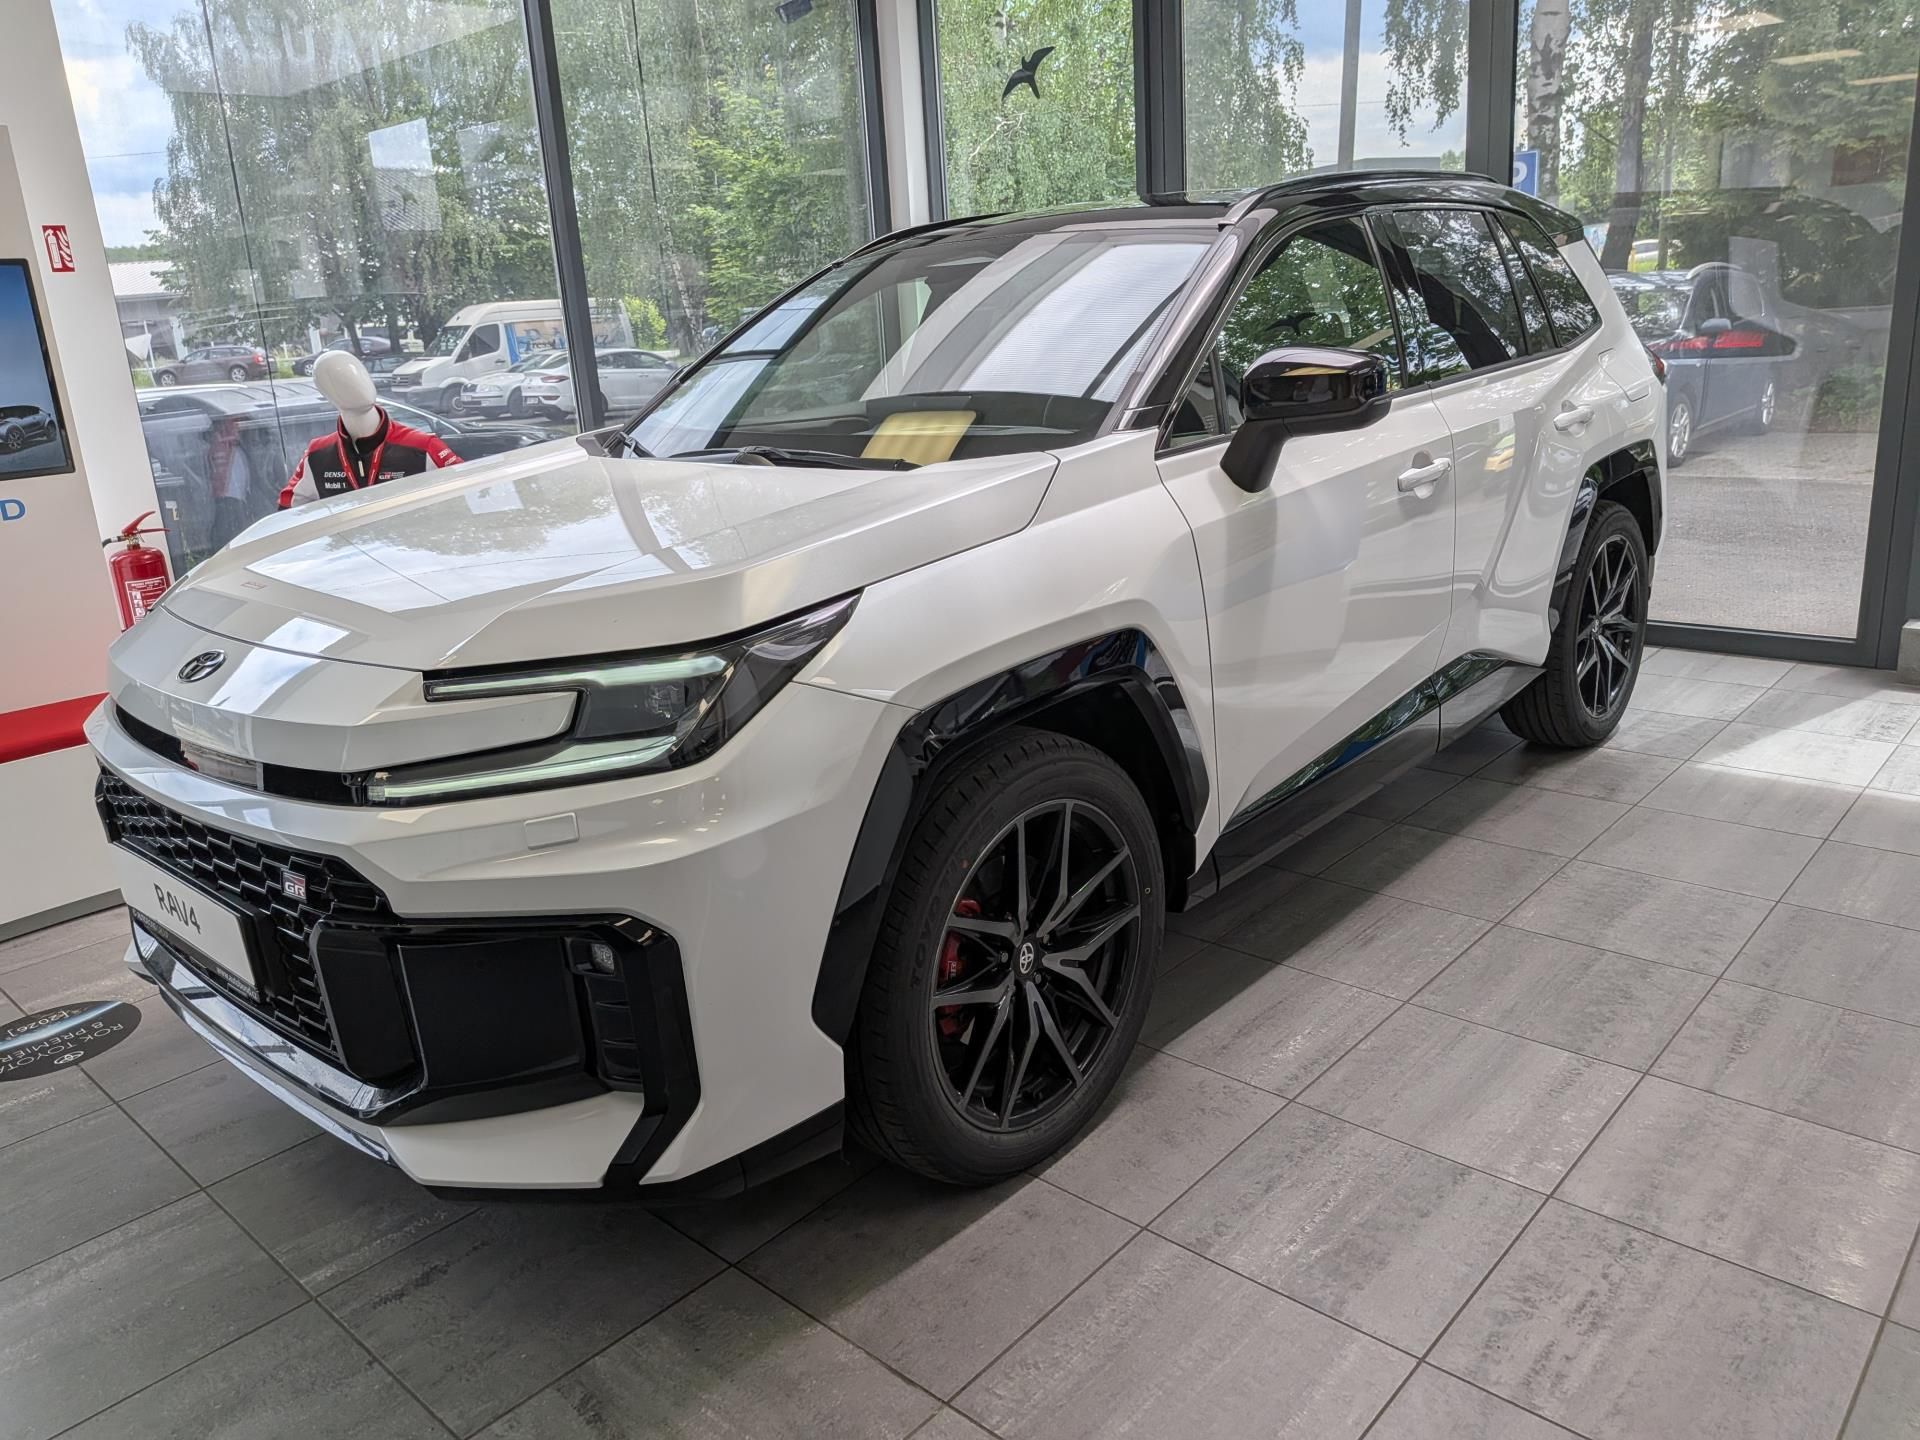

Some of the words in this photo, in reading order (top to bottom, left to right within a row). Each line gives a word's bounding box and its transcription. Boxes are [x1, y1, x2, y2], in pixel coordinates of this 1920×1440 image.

[284, 881, 306, 897] GR
[154, 882, 202, 935] RAV4
[80, 1023, 124, 1042] ROK
[91, 1021, 104, 1029] 8
